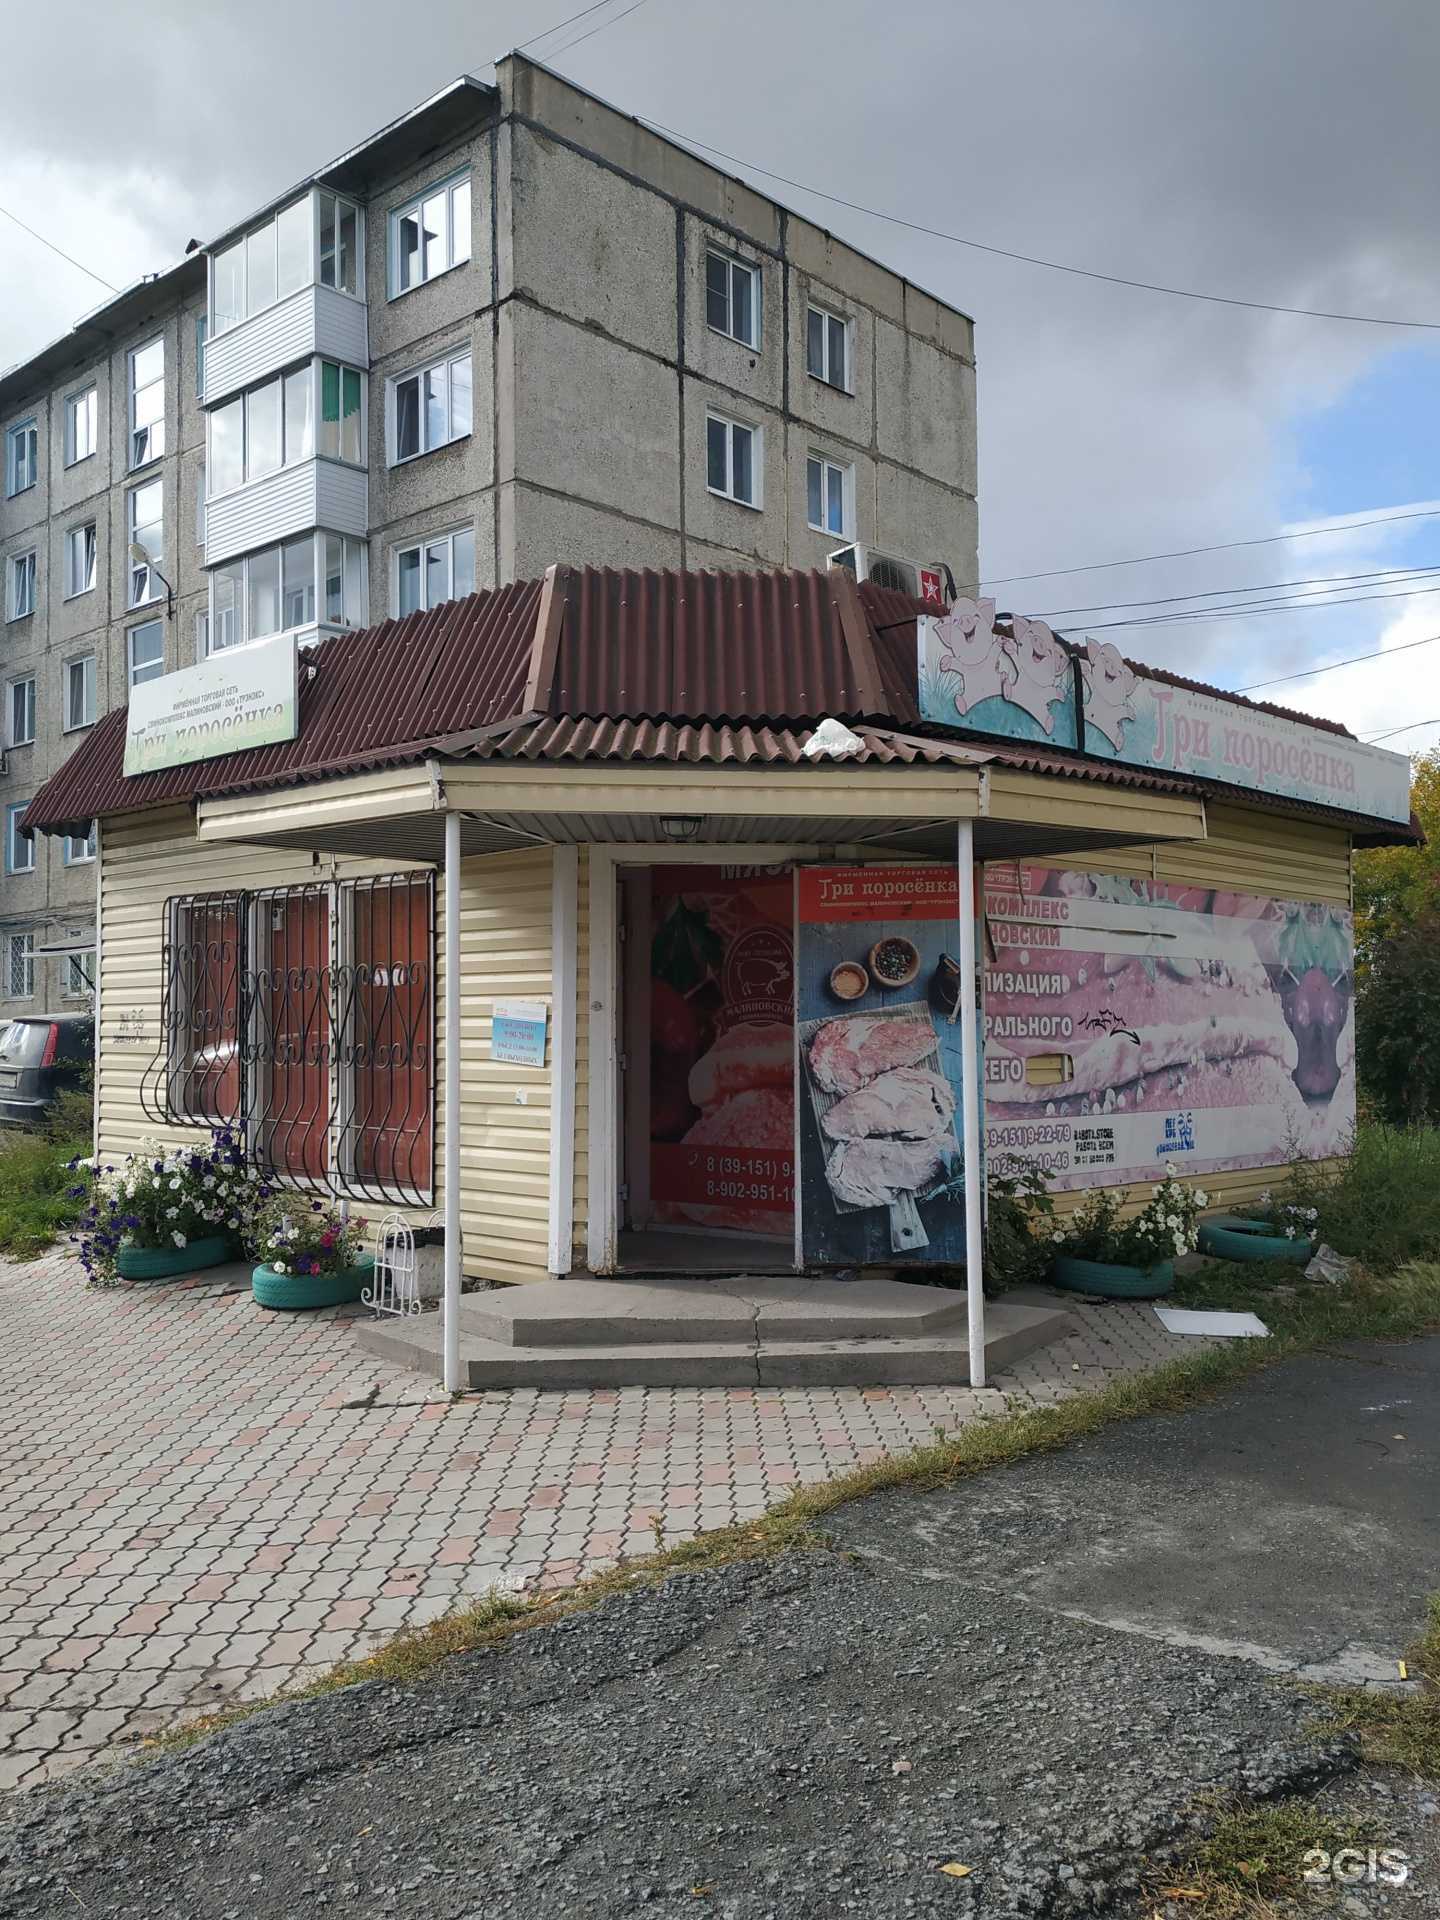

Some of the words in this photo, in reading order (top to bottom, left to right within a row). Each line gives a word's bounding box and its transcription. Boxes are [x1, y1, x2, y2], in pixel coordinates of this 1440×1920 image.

[1150, 689, 1210, 767] Три
[1224, 727, 1356, 791] поросёнка
[818, 878, 854, 899] Три
[863, 878, 958, 897] поросёнка
[986, 895, 1070, 920] КОМПЛЕКС
[984, 1015, 1073, 1037] РАЛЬНОГО
[985, 1059, 1023, 1081] ЕГО
[707, 1156, 714, 1171] 8
[720, 1158, 776, 1180] (39-151)
